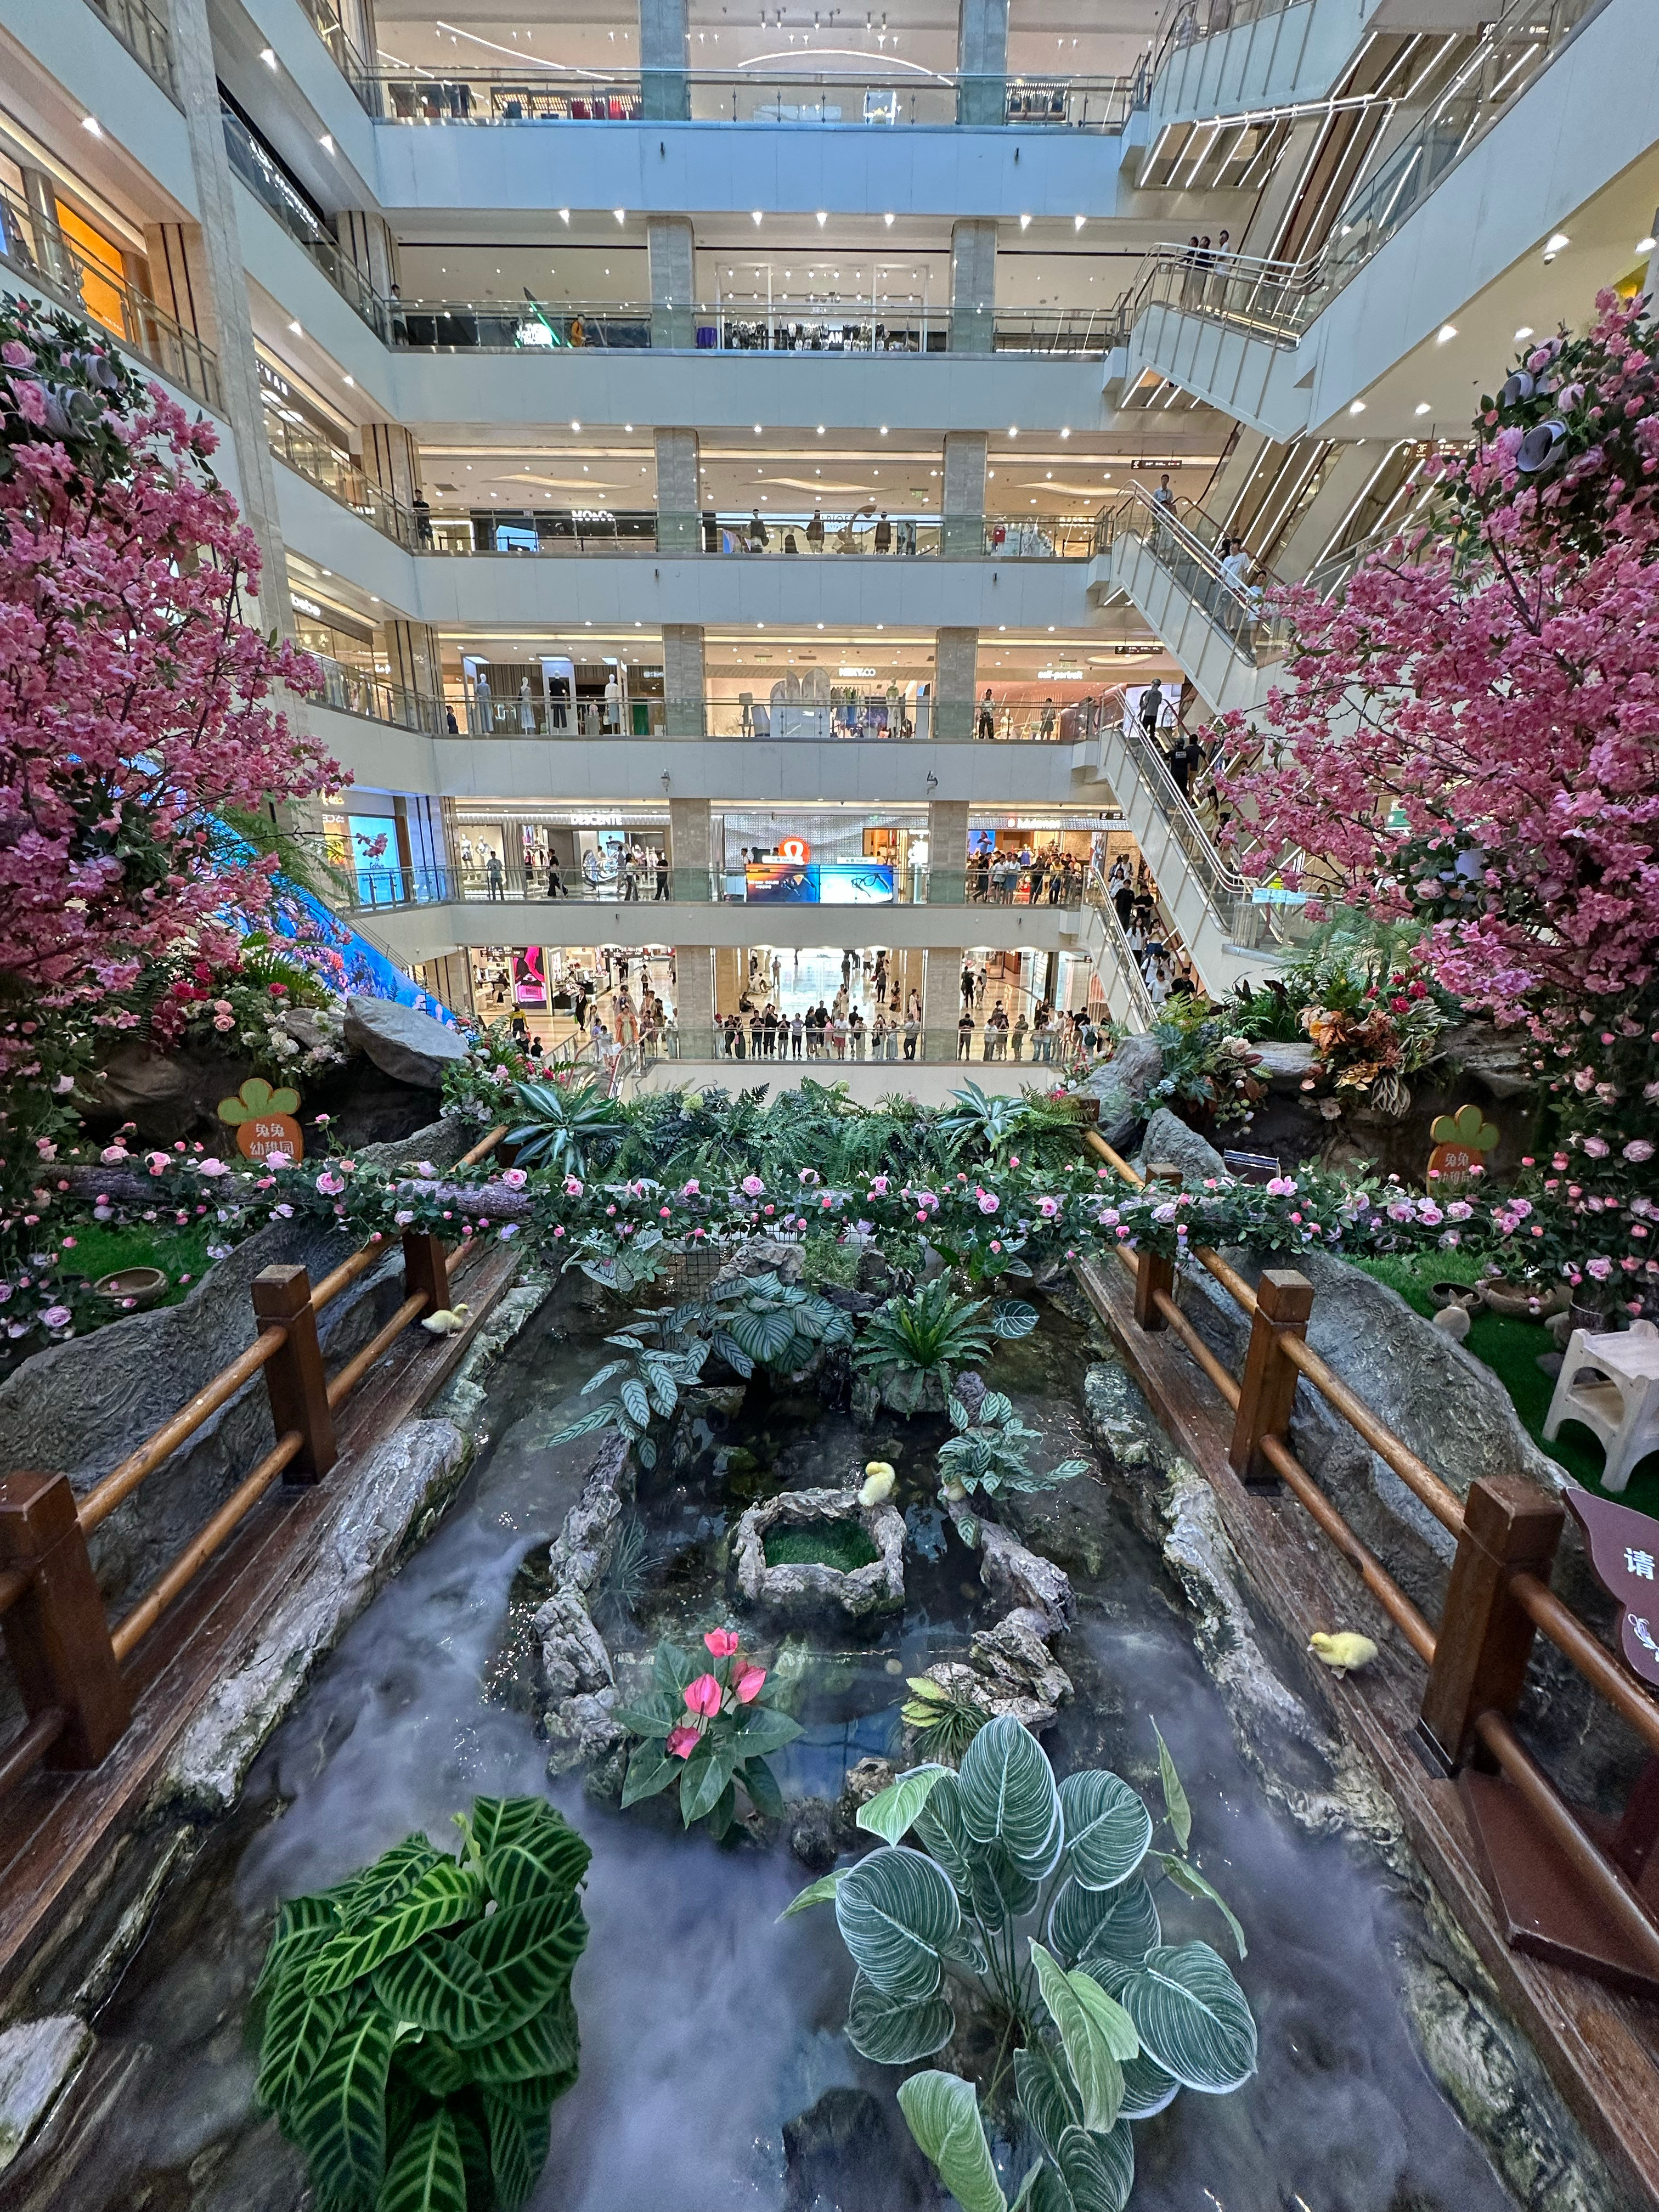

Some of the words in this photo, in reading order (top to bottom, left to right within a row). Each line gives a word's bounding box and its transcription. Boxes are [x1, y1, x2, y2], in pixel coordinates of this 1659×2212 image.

[571, 814, 623, 826] DESCENTE
[256, 1123, 285, 1137] 兔兔
[249, 1141, 295, 1155] 幼稚园
[1445, 1151, 1469, 1167] 兔兔
[1623, 1547, 1656, 1581] 请
